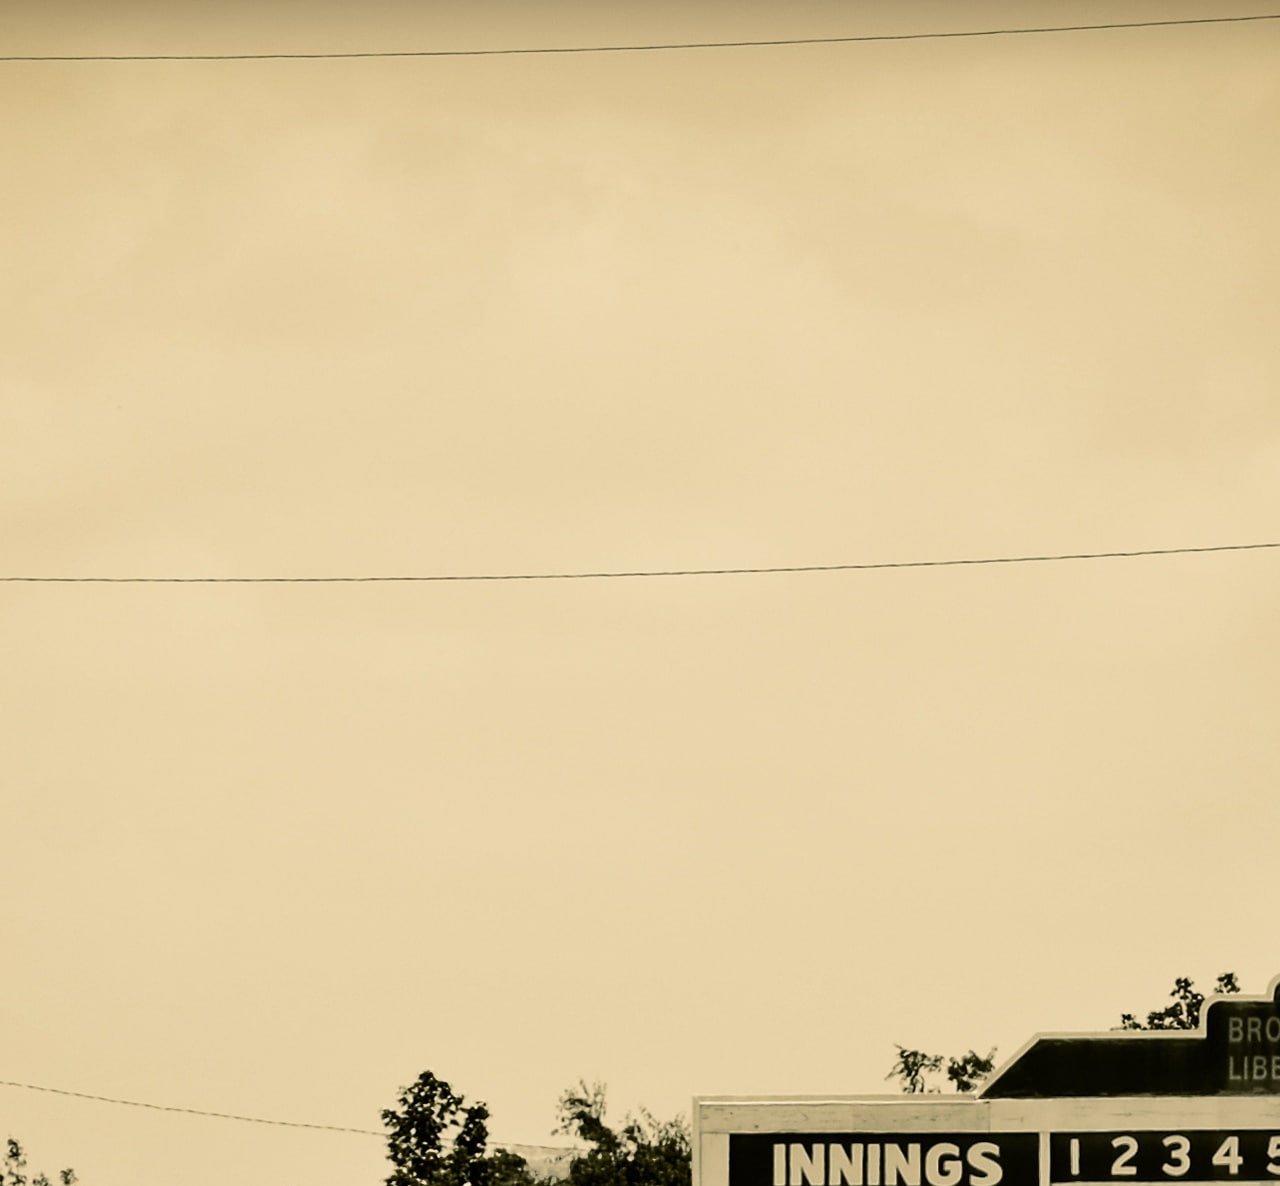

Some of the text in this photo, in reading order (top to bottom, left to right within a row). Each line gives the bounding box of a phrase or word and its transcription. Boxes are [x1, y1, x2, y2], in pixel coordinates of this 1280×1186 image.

[1070, 1138, 1080, 1176] 1
[1110, 1135, 1139, 1176] 2
[1161, 1134, 1191, 1177] 3
[1211, 1135, 1244, 1175] 4
